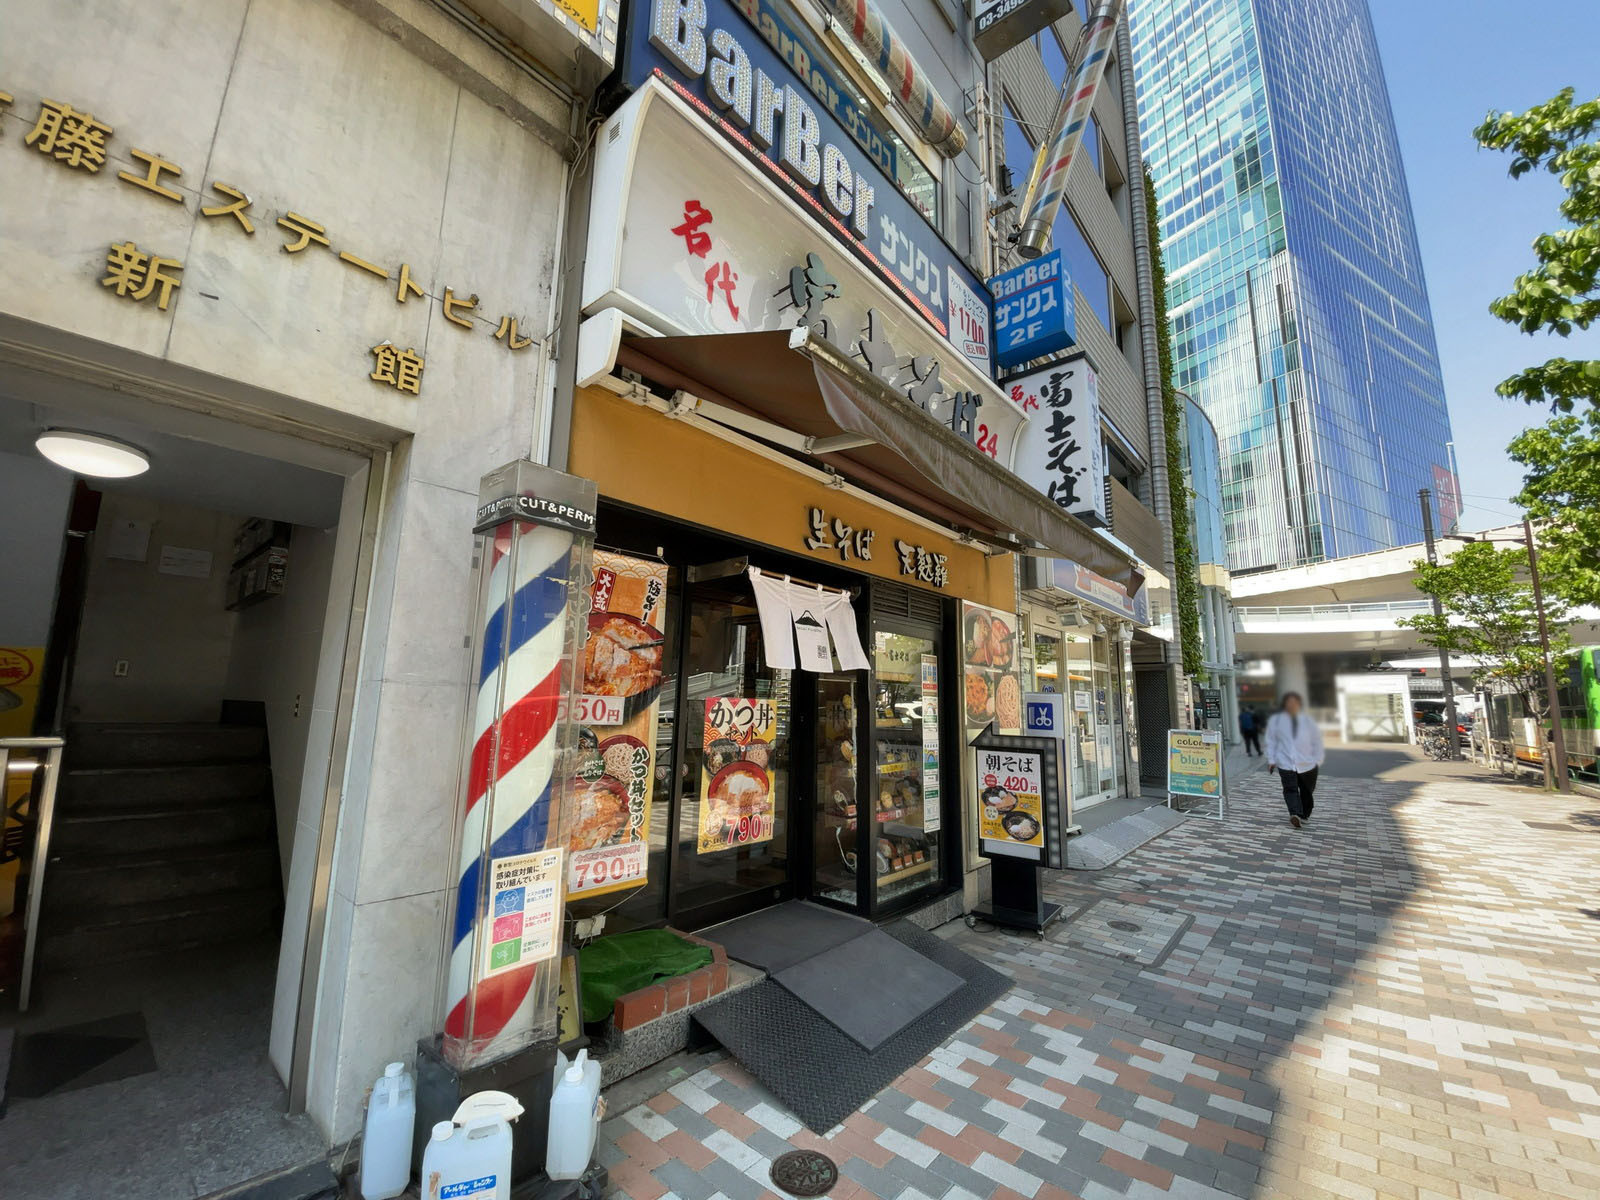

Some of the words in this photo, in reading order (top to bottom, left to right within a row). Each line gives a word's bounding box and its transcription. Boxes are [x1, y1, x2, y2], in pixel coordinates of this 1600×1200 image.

[979, 0, 1025, 30] 03-349
[880, 213, 943, 313] サンクス
[991, 257, 1060, 300] BarBer
[995, 285, 1058, 331] サンクス
[1009, 319, 1043, 346] 2F
[1011, 385, 1040, 412] 名代
[1040, 371, 1087, 508] 富士そば
[519, 496, 594, 525] CUT&PERM
[805, 507, 875, 561] 生そば
[593, 572, 612, 612] 大人気
[710, 701, 774, 730] かつ丼
[725, 726, 758, 743] セット
[985, 753, 1034, 773] 朝そば
[1180, 754, 1207, 766] blue
[1003, 775, 1038, 794] 420円
[495, 872, 547, 890] 取り組んでいます
[496, 865, 540, 880] 感染症対策に
[575, 857, 641, 889] 790円
